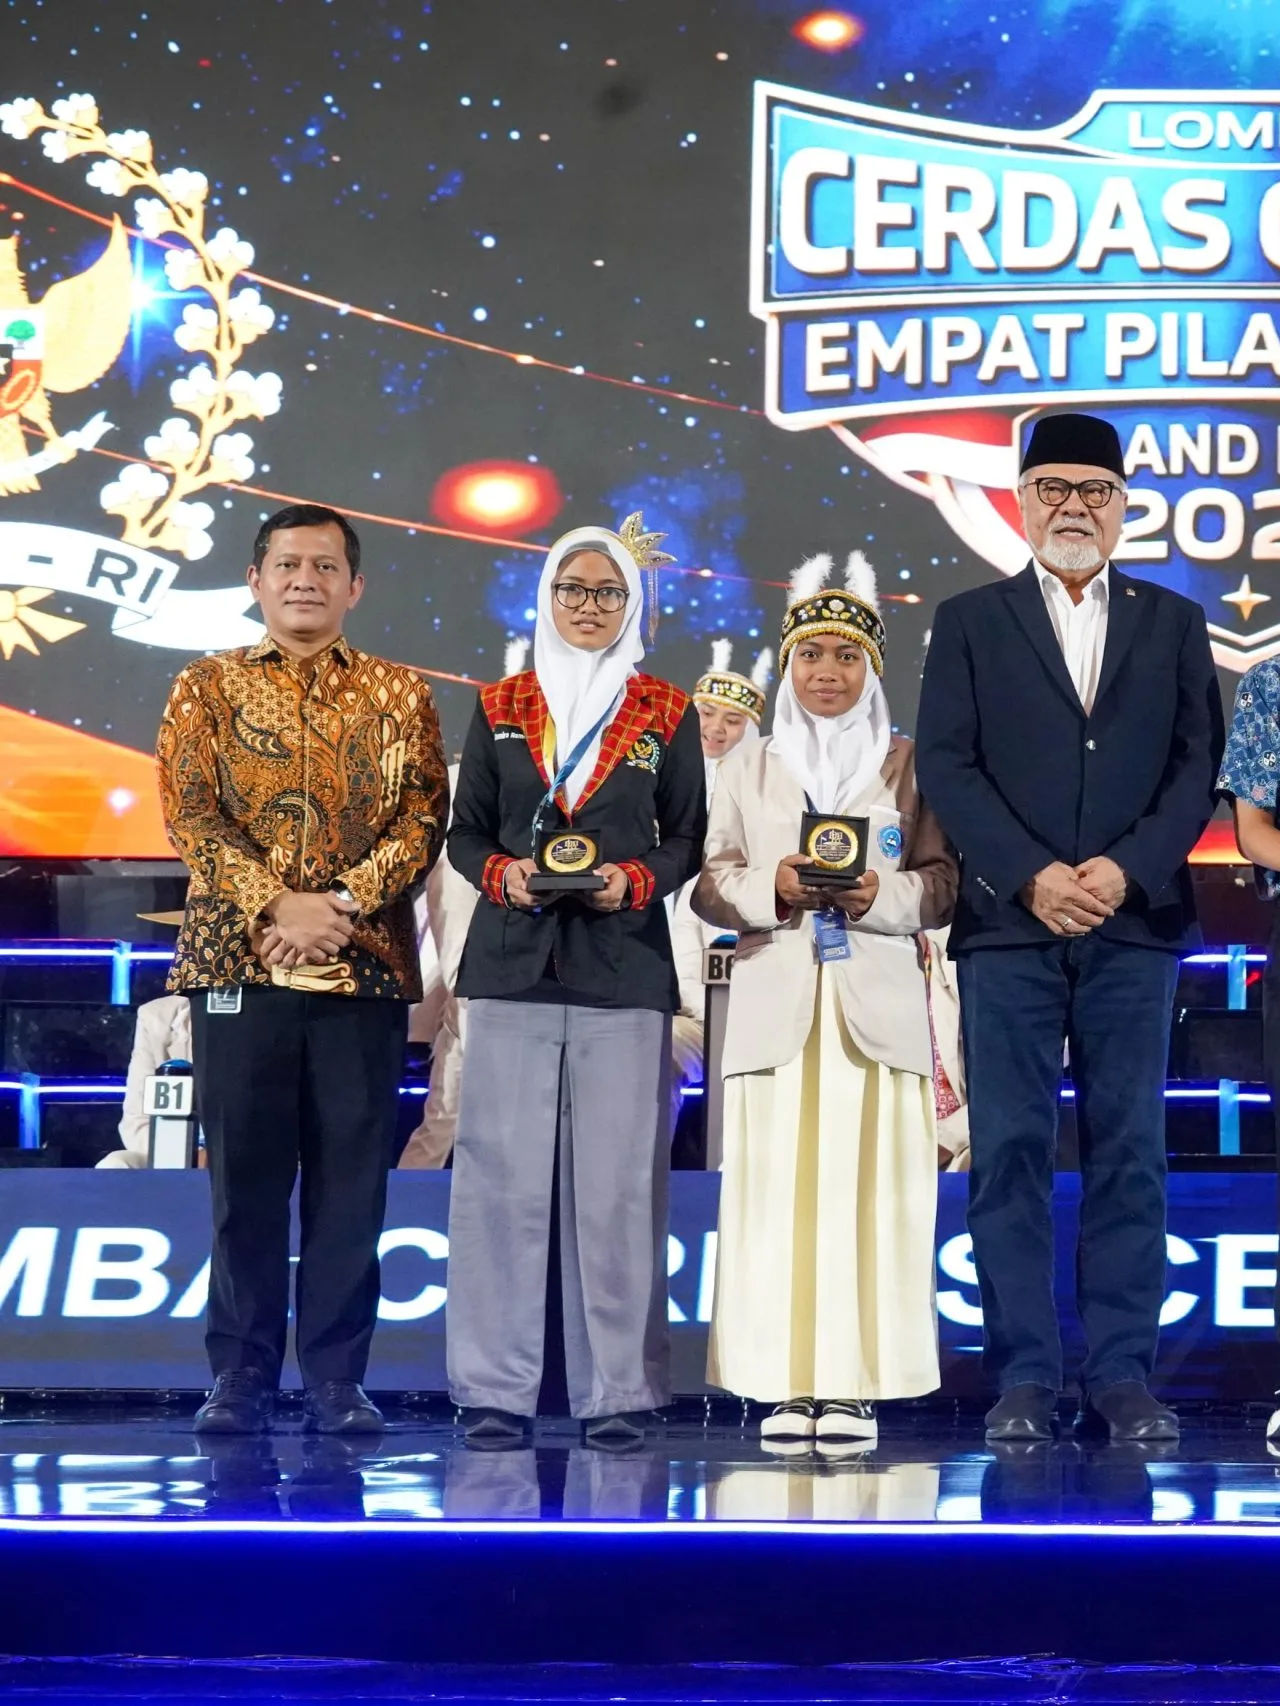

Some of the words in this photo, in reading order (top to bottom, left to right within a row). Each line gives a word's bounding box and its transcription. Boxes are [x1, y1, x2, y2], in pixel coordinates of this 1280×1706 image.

[781, 149, 1230, 273] CERDAS
[805, 314, 1084, 393] EMPAT
[1124, 424, 1259, 476] AND
[86, 548, 163, 603] RI
[154, 1082, 183, 1110] B1
